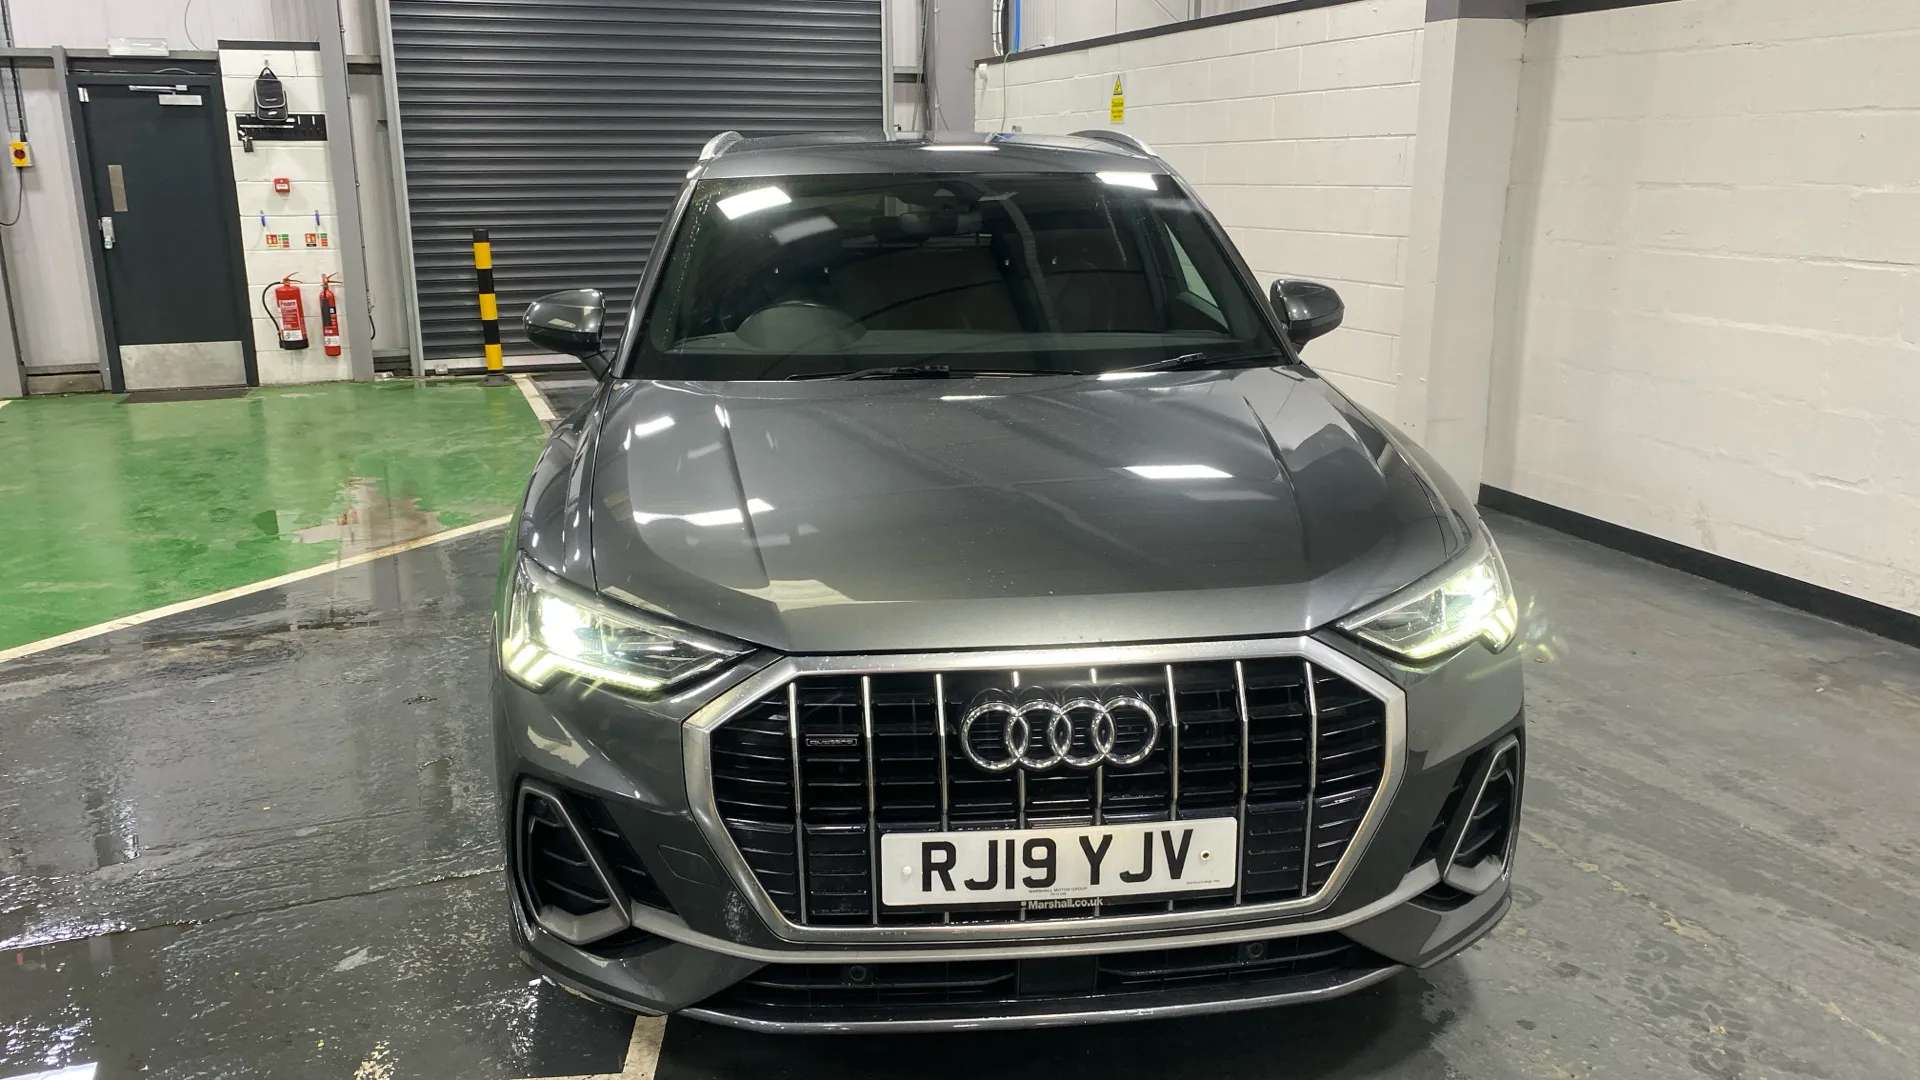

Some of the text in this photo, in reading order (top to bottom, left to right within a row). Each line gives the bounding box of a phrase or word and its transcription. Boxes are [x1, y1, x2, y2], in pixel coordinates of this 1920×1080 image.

[922, 829, 1194, 892] RJ19 YJV
[1028, 897, 1104, 909] Marshall.co.uk
